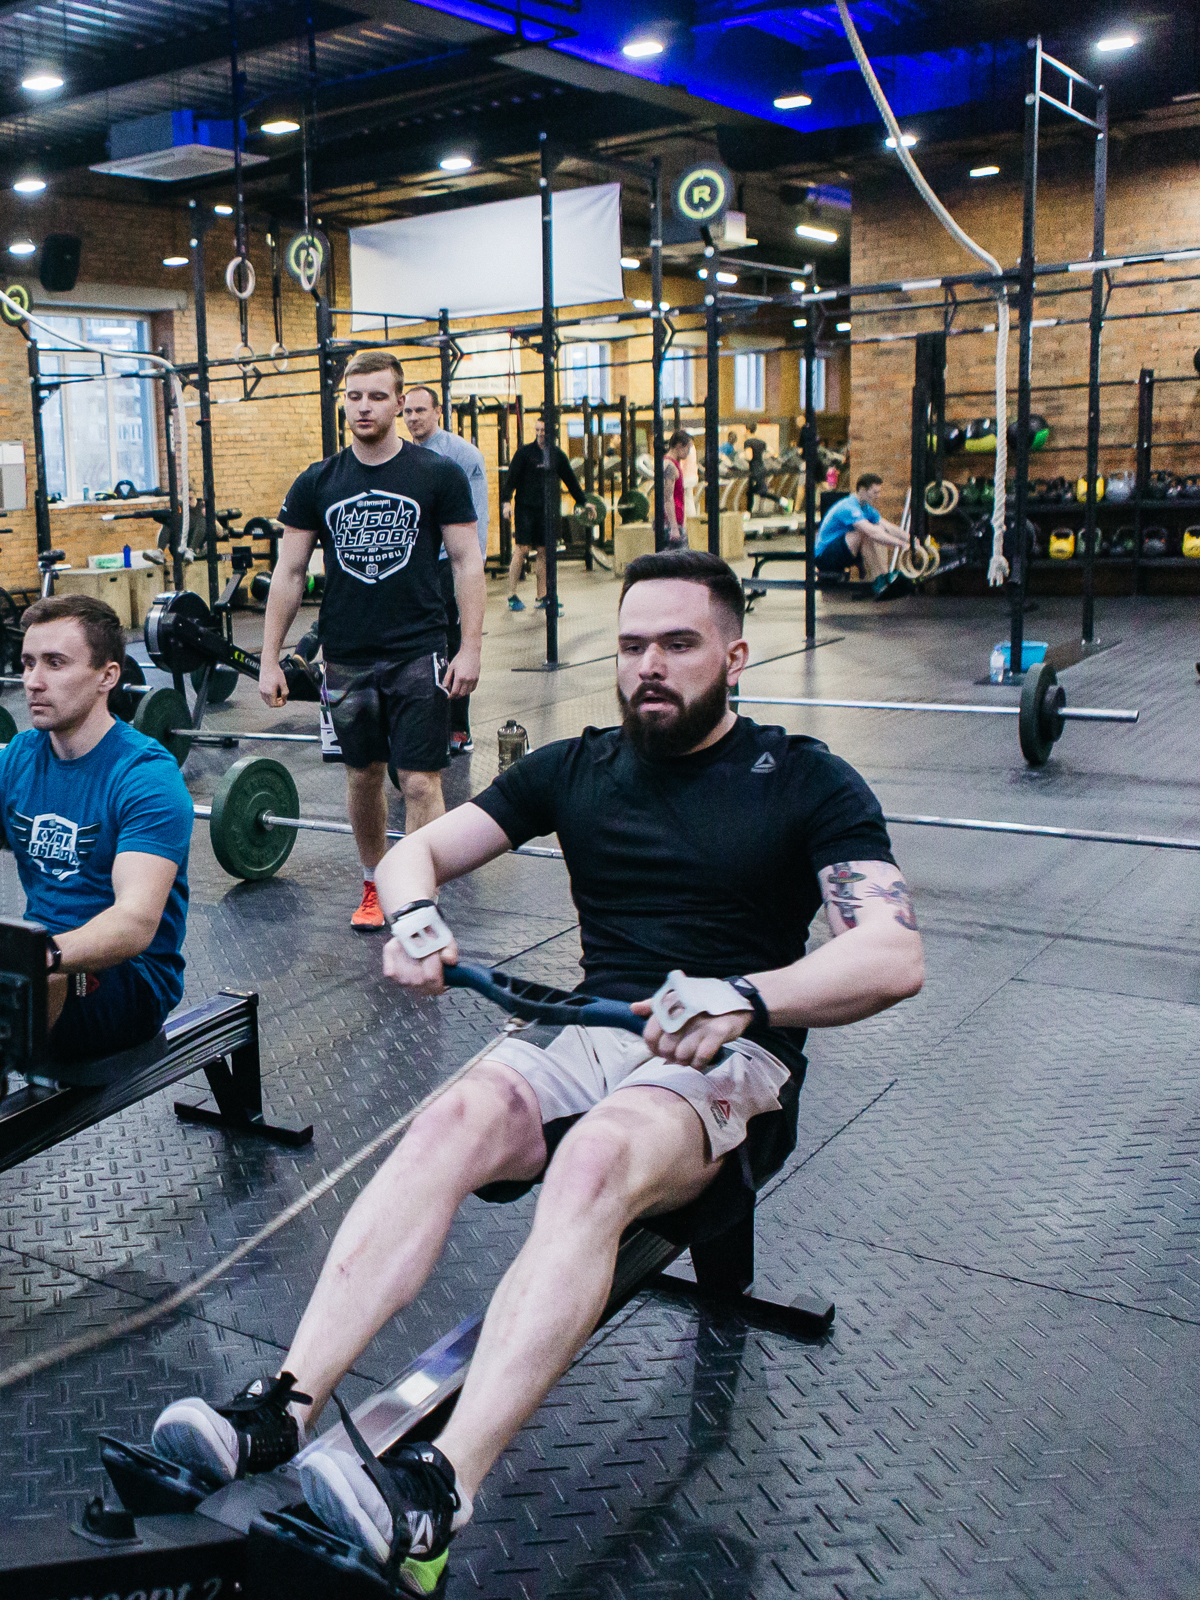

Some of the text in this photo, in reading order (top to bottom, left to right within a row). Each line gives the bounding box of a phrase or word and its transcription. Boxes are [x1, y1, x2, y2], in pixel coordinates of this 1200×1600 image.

[336, 500, 414, 534] КУБОК
[335, 528, 419, 548] ВЫЗОВА
[344, 550, 402, 563] РАТИБОРЕЦ
